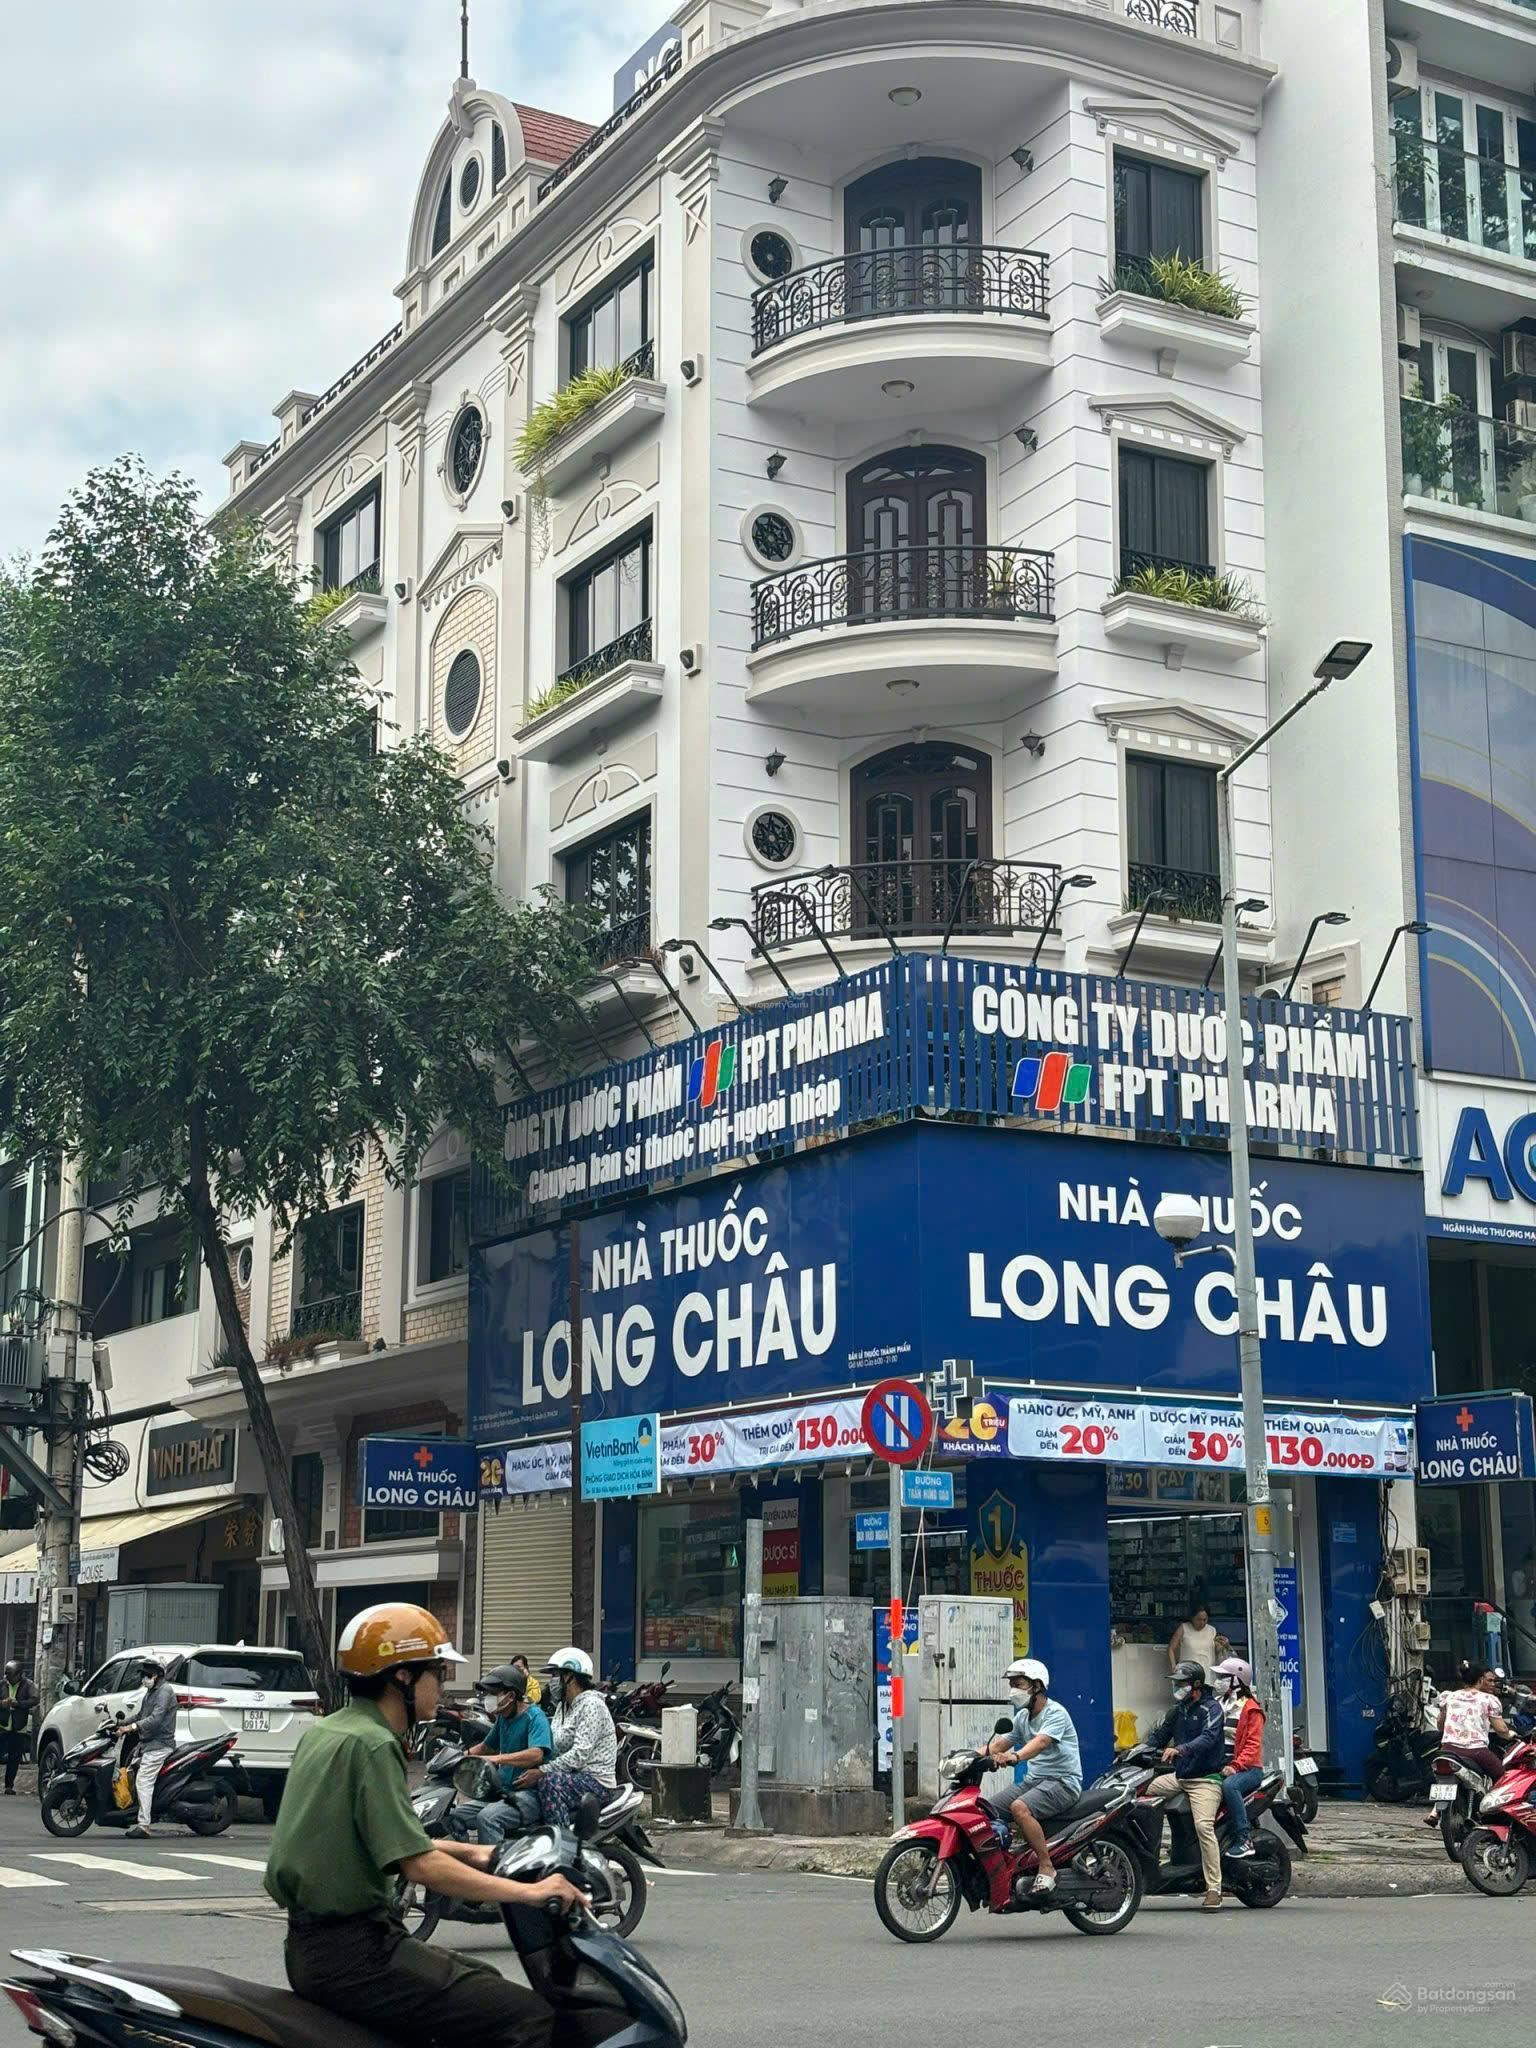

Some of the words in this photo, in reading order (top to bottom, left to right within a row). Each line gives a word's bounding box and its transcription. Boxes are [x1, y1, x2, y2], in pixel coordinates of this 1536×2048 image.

[972, 977, 1079, 1045] CÔNG
[1091, 1002, 1139, 1053] TY
[1150, 1007, 1254, 1073] DƯỢC
[1264, 1013, 1368, 1080] PHẨM
[503, 1111, 540, 1162] ÔNG
[541, 1104, 566, 1150] TY
[569, 1083, 622, 1141] DƯỢC
[626, 1054, 683, 1123] PHẨM
[741, 1028, 781, 1084] FPT
[783, 990, 884, 1070] PHARMA
[1103, 1063, 1168, 1117] FPT
[1180, 1072, 1337, 1135] PHARMA
[528, 1155, 587, 1204] Chuyên
[590, 1143, 621, 1187] bán
[624, 1132, 641, 1176] sỉ
[645, 1116, 695, 1171] thuốc
[790, 1074, 841, 1125] nhập
[1059, 1176, 1150, 1227] NHÀ
[1161, 1180, 1303, 1241] UỐC
[592, 1220, 653, 1292] NHÀ
[660, 1182, 769, 1276] THUỐC
[1443, 1222, 1465, 1233] NGÂN
[1466, 1224, 1489, 1236] HÀNG
[1489, 1226, 1524, 1239] THƯƠNG
[968, 1252, 1171, 1331] LONG
[1195, 1262, 1388, 1348] CHÂU
[522, 1304, 656, 1405] LONG
[672, 1251, 837, 1377] CHÂU
[1017, 1402, 1053, 1417] HÀNG
[1108, 1408, 1136, 1421] ANH
[1150, 1411, 1187, 1425] DƯỢC
[1190, 1410, 1206, 1425] MỸ
[742, 1424, 769, 1441] THÊM
[772, 1418, 793, 1440] QUÀ
[1036, 1428, 1058, 1439] GIẢM
[1265, 1419, 1300, 1433] THÊM
[1304, 1420, 1331, 1435] QUÀ
[586, 1437, 640, 1459] VietinBank
[663, 1435, 685, 1451] PHẨM
[779, 1442, 794, 1453] ĐẾN
[943, 1442, 975, 1452] KHÁCH
[977, 1441, 1001, 1453] HÀNG
[1040, 1439, 1058, 1450] ĐẾN
[1164, 1433, 1186, 1445] GIẢM
[1436, 1436, 1458, 1451] NHÀ
[1460, 1431, 1498, 1450] THUỐC
[671, 1455, 685, 1466] ĐẾN
[1168, 1445, 1186, 1456] ĐẾN
[1420, 1459, 1465, 1479] LONG
[1469, 1451, 1517, 1477] CHÂU
[388, 1468, 413, 1482] NHÀ
[417, 1468, 457, 1484] THUỐC
[367, 1487, 419, 1505] LONG
[424, 1486, 477, 1507] CHÂU
[763, 1544, 788, 1566] DƯỢC
[974, 1565, 1025, 1593] THUỐC
[1279, 1658, 1299, 1673] UỐC
